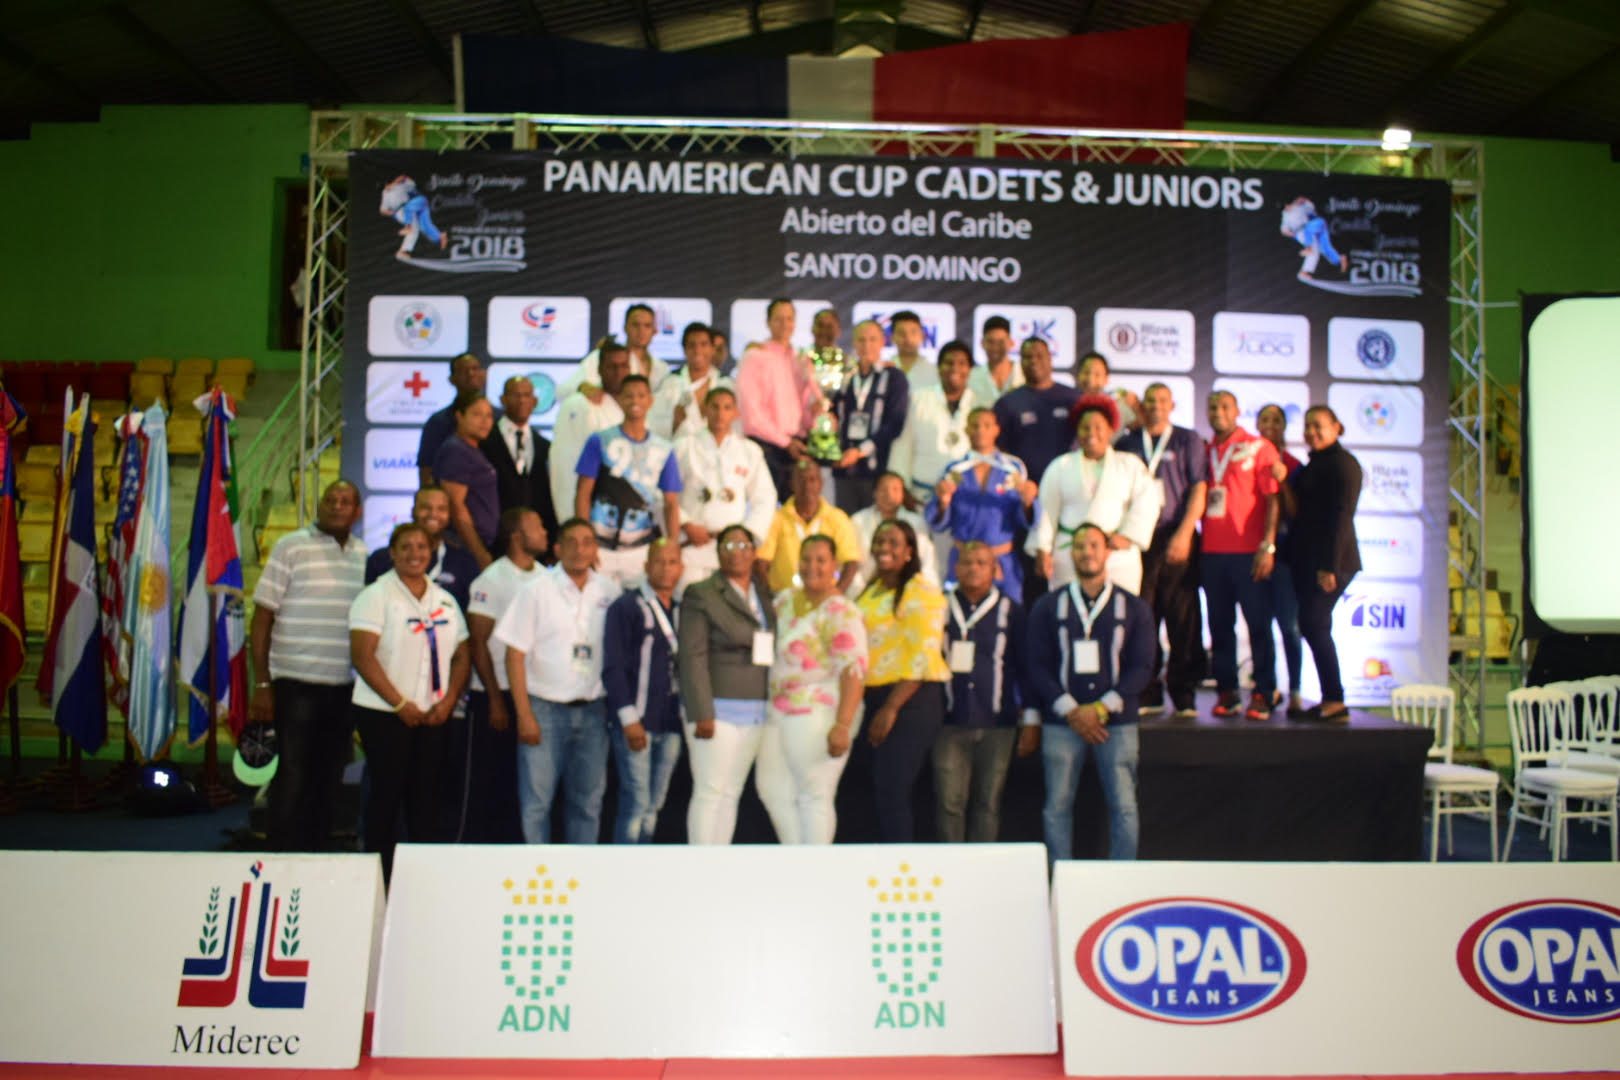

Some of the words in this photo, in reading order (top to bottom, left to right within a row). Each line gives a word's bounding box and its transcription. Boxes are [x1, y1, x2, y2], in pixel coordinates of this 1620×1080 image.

[544, 160, 821, 196] PANAMERICAN
[829, 164, 907, 198] CUP
[915, 166, 1063, 203] CADETS
[1071, 171, 1099, 204] &
[1106, 173, 1264, 211] JUNIORS
[780, 206, 887, 236] Abierto
[891, 208, 936, 237] del
[941, 211, 1032, 240] Caribe
[450, 235, 526, 260] 2018
[783, 251, 878, 280] SANTO
[882, 254, 1022, 284] DOMINGO
[1350, 258, 1420, 285] 2018
[1369, 604, 1405, 628] SIN
[1103, 925, 1281, 985] OPAL
[1152, 989, 1239, 1007] JEANS
[1533, 989, 1615, 1007] JEANS
[498, 1004, 571, 1033] ADN
[874, 1001, 946, 1029] ADN
[171, 1024, 300, 1055] Miderec
